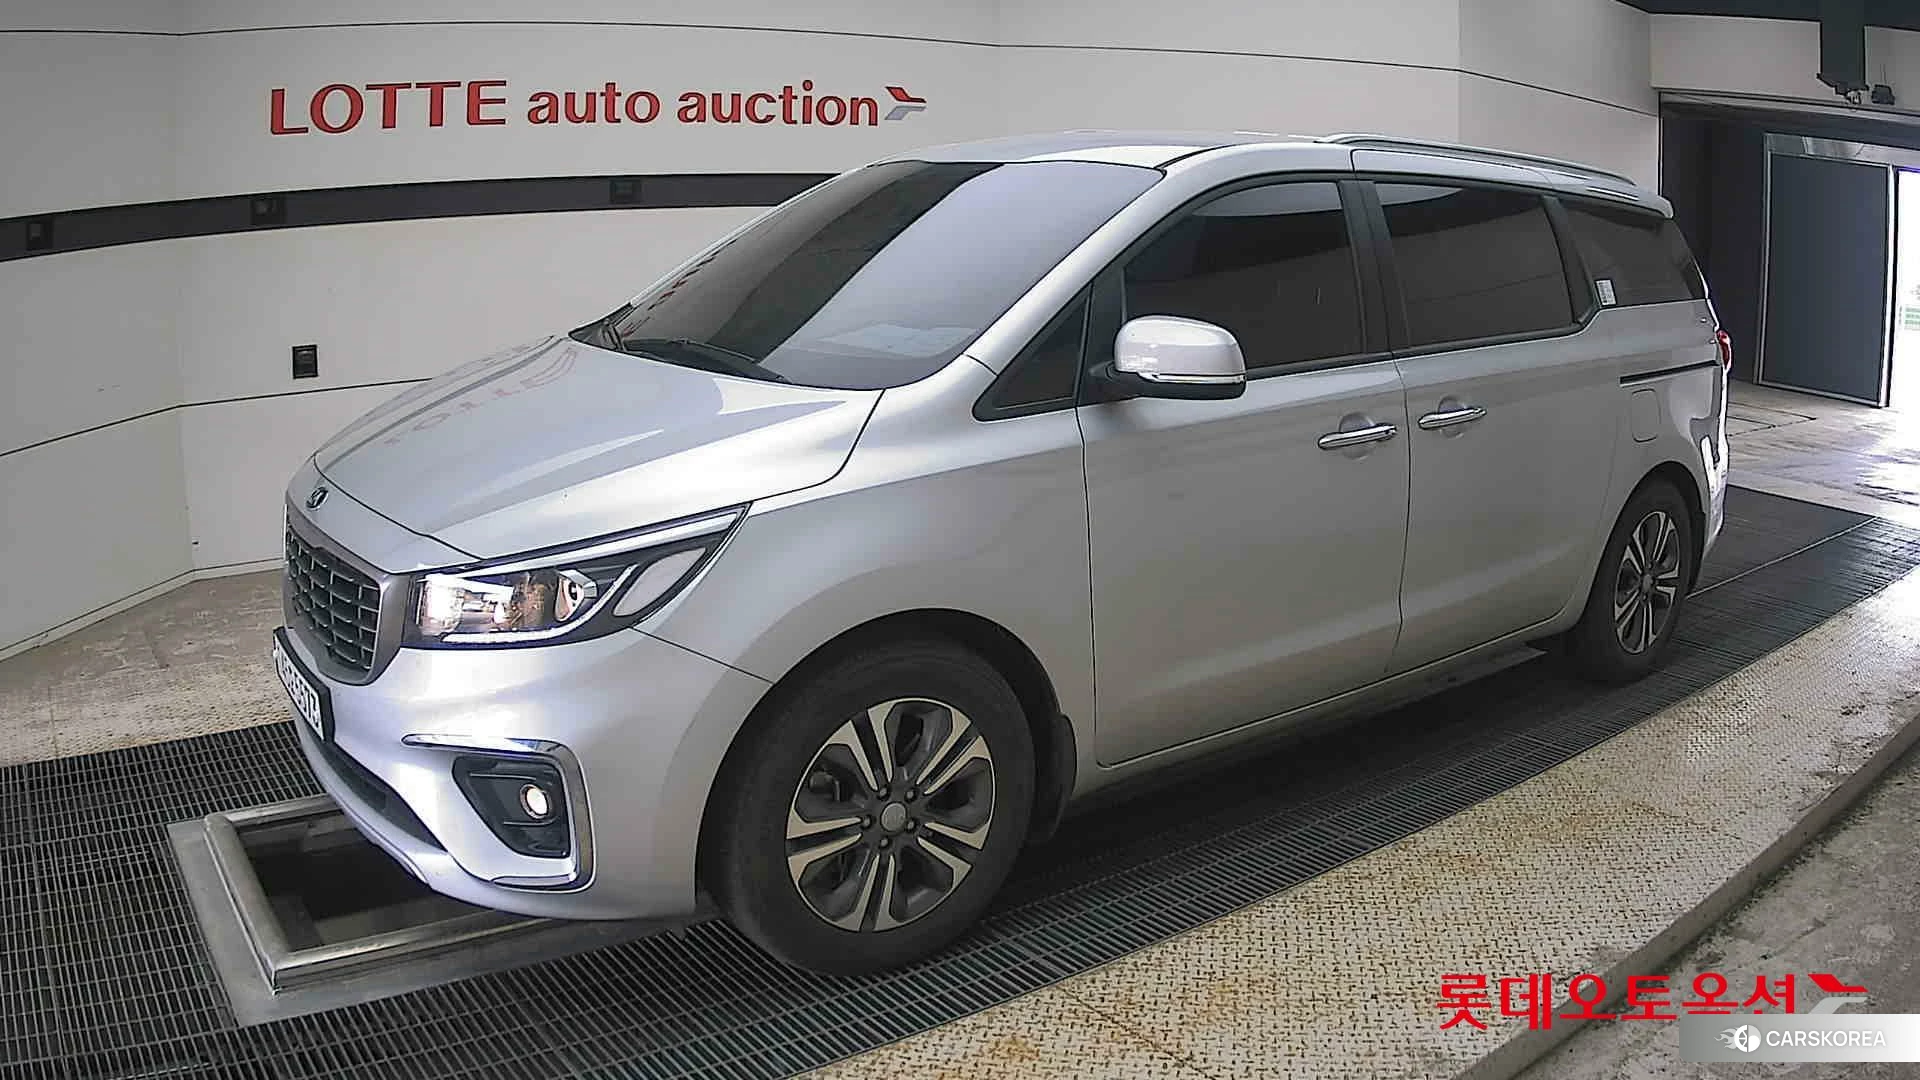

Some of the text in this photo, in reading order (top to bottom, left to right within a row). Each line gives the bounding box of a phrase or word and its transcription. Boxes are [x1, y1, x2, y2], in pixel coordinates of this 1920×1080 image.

[269, 80, 879, 135] LOTTE auto auction
